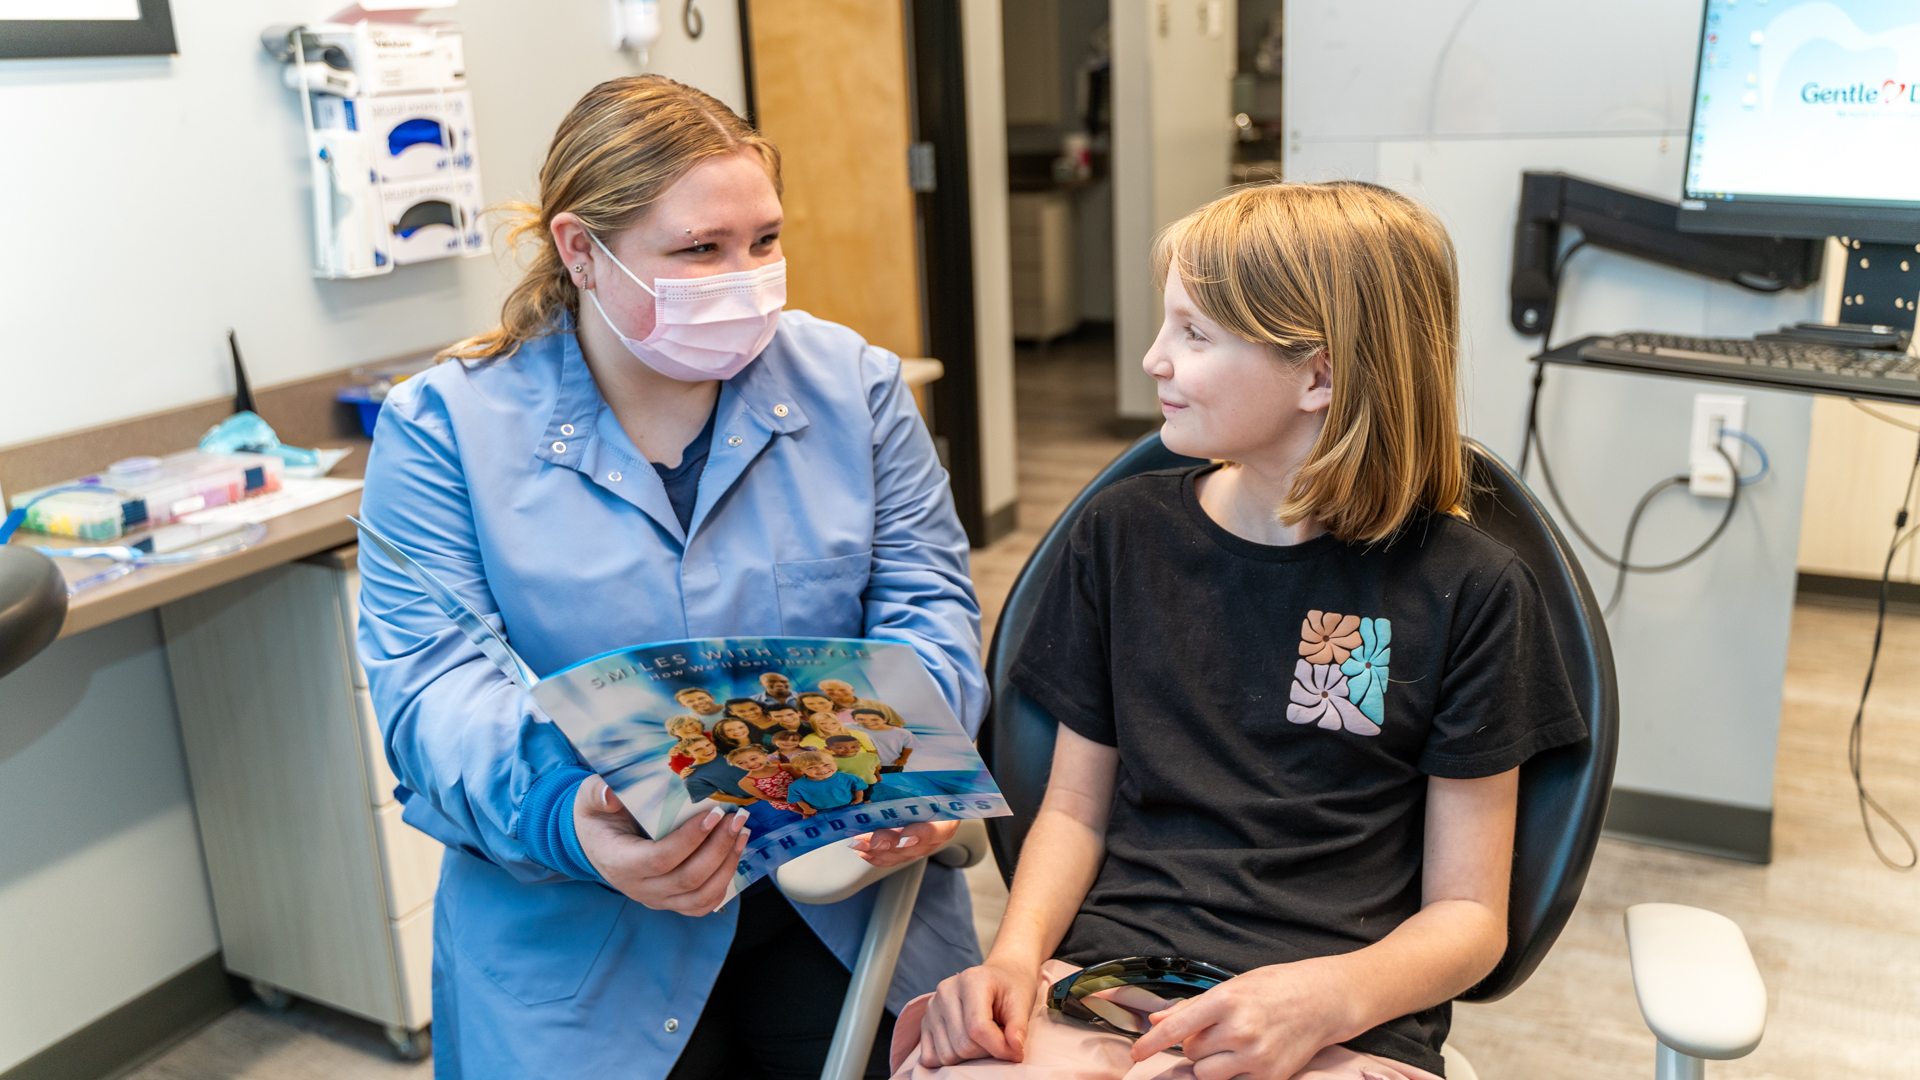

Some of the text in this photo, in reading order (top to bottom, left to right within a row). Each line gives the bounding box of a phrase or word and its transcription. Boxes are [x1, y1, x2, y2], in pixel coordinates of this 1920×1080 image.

[1801, 81, 1878, 104] Gentle
[590, 647, 872, 689] SMILES WITH STYLE
[649, 658, 826, 681] How We'll Get There
[737, 799, 993, 876] RTHODONTICS
